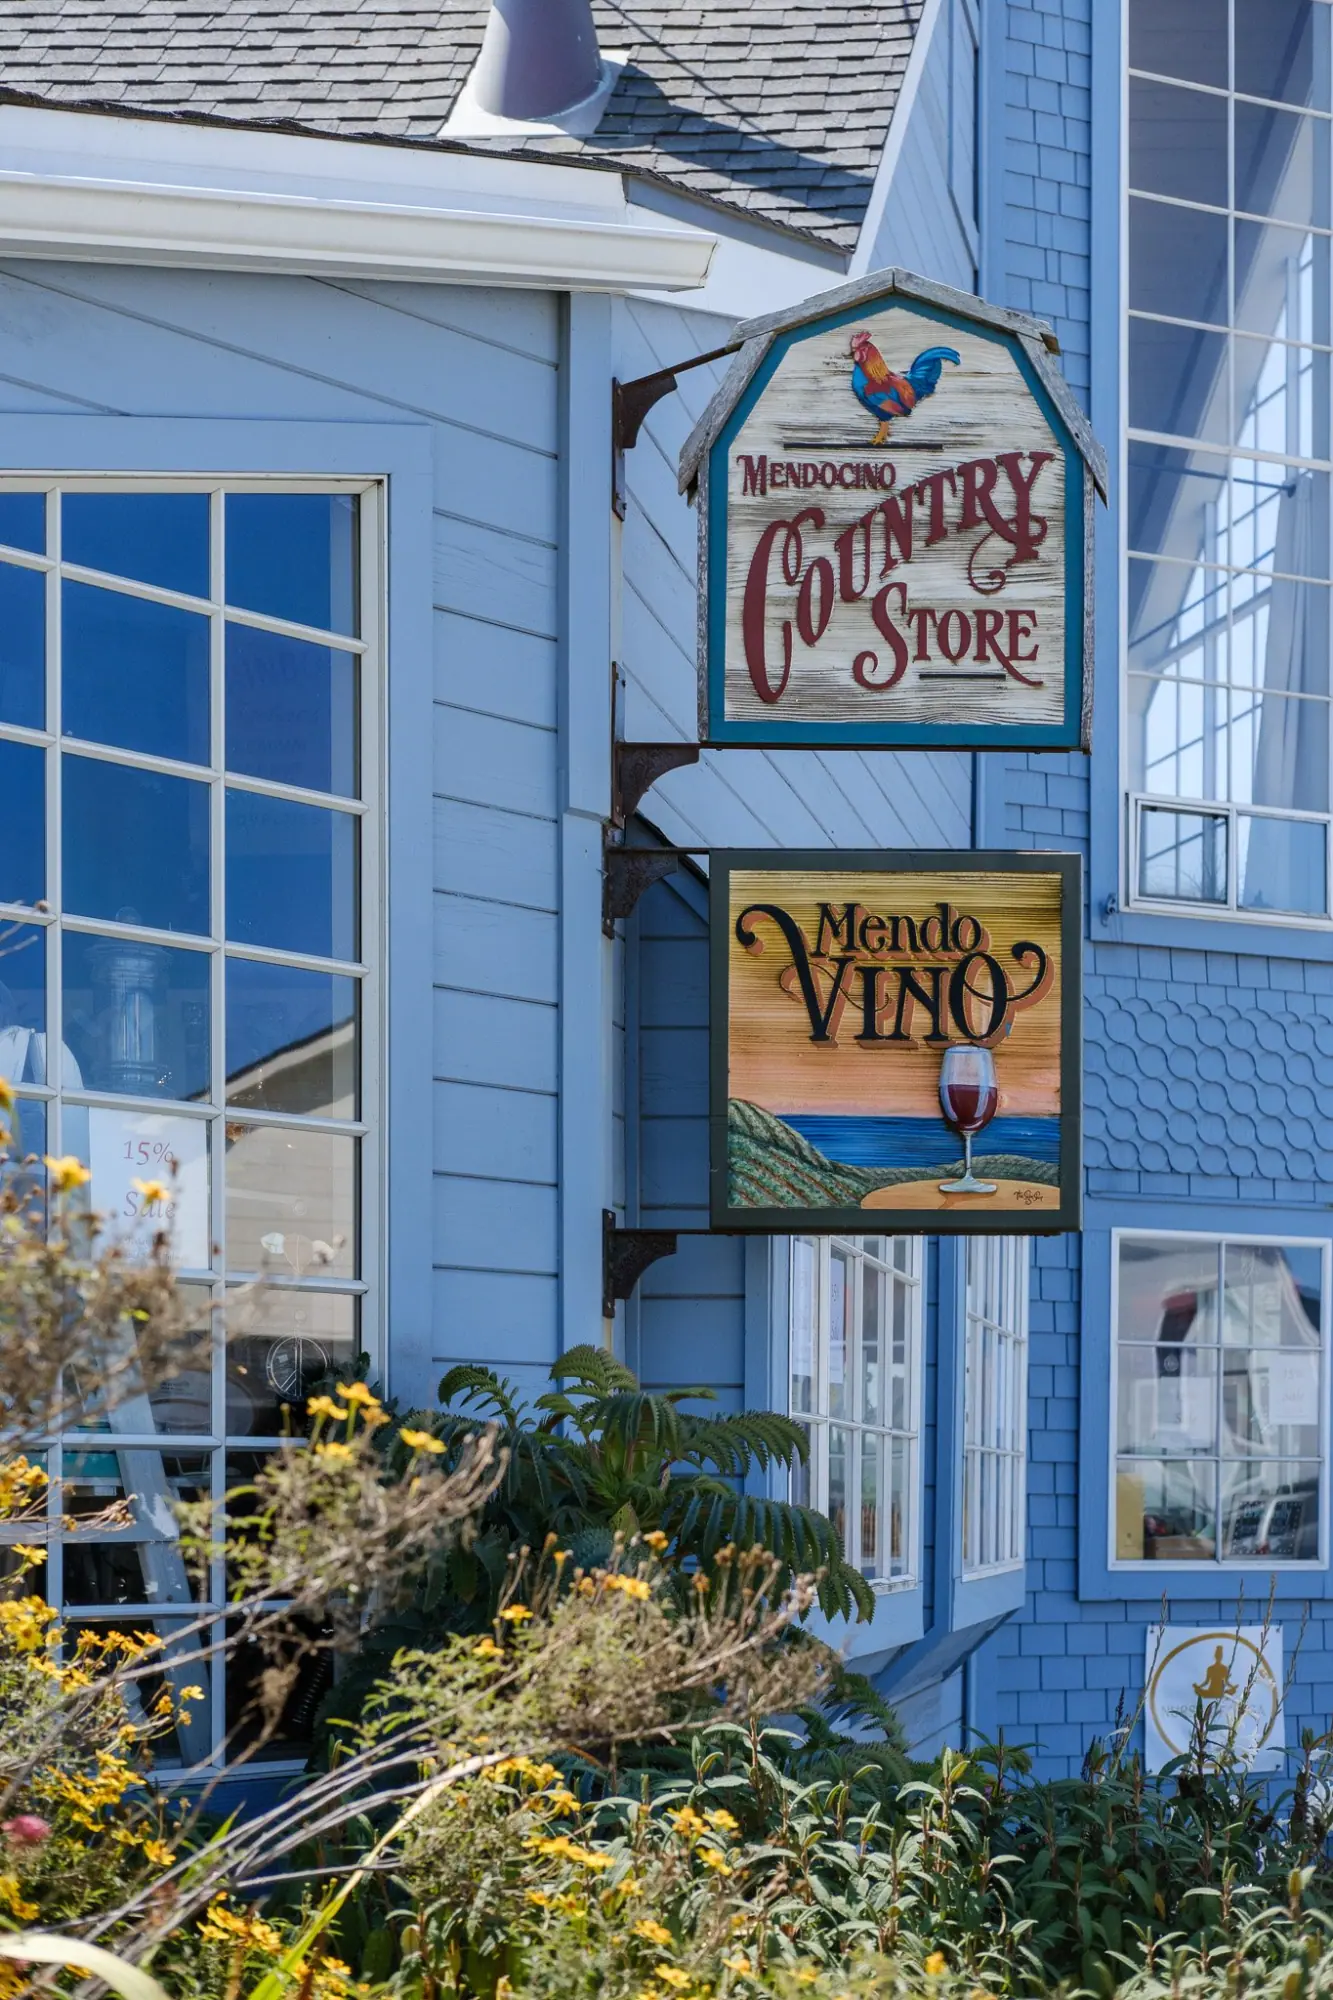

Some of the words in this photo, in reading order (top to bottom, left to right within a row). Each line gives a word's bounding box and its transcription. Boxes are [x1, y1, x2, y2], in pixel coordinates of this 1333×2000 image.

[736, 453, 896, 496] MENDOCINO
[742, 451, 1056, 704] COUNTRY
[852, 581, 1044, 690] STORE
[811, 902, 992, 959] Mendo
[735, 903, 1055, 1048] VINO
[123, 1140, 174, 1166] 15%
